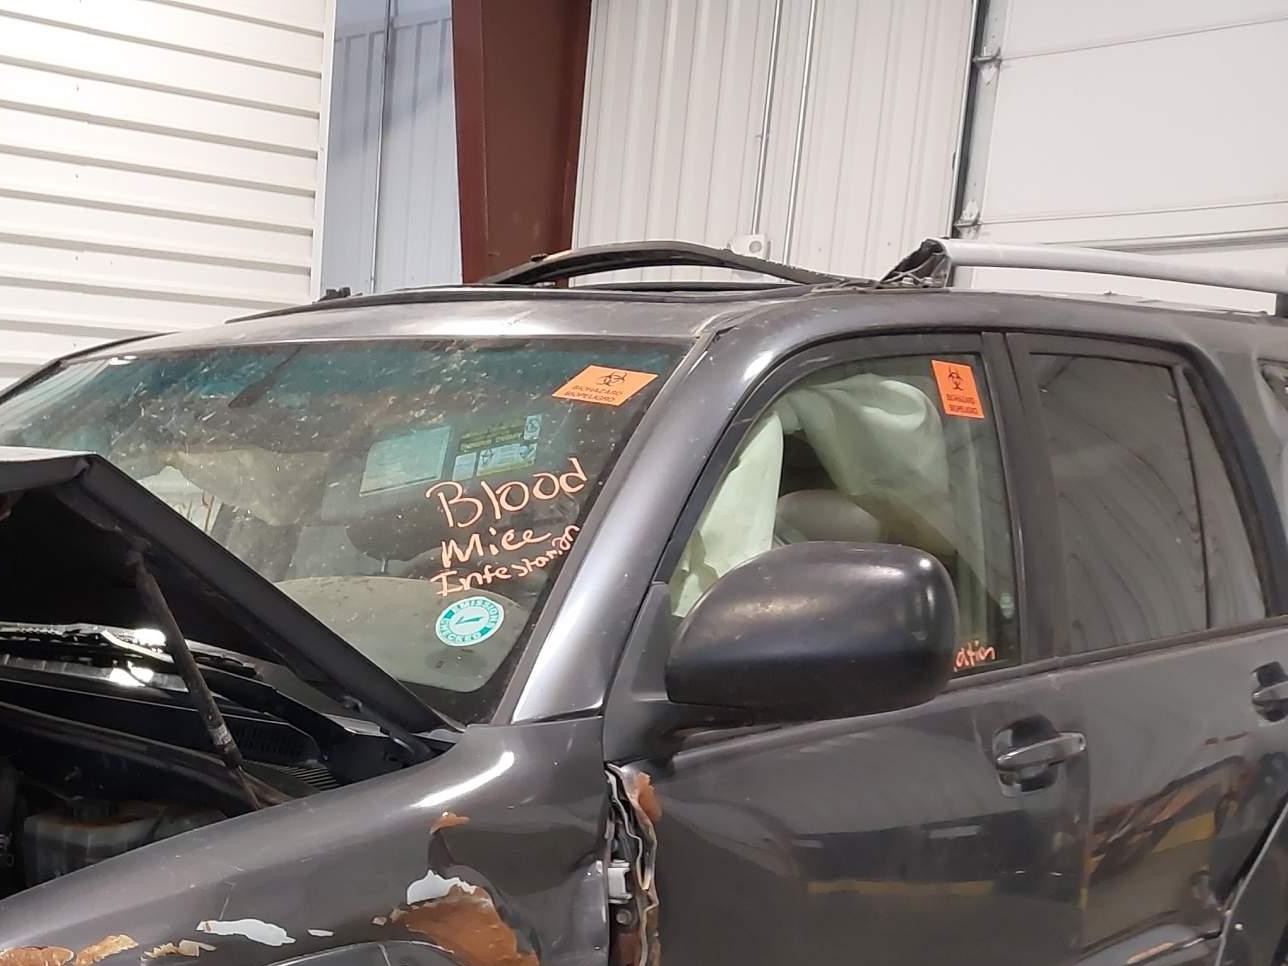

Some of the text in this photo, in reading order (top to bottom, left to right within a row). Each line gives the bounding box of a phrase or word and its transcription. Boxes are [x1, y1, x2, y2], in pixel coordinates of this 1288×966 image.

[425, 457, 588, 528] Blood
[441, 527, 552, 568] Mice
[953, 640, 996, 672] ation
